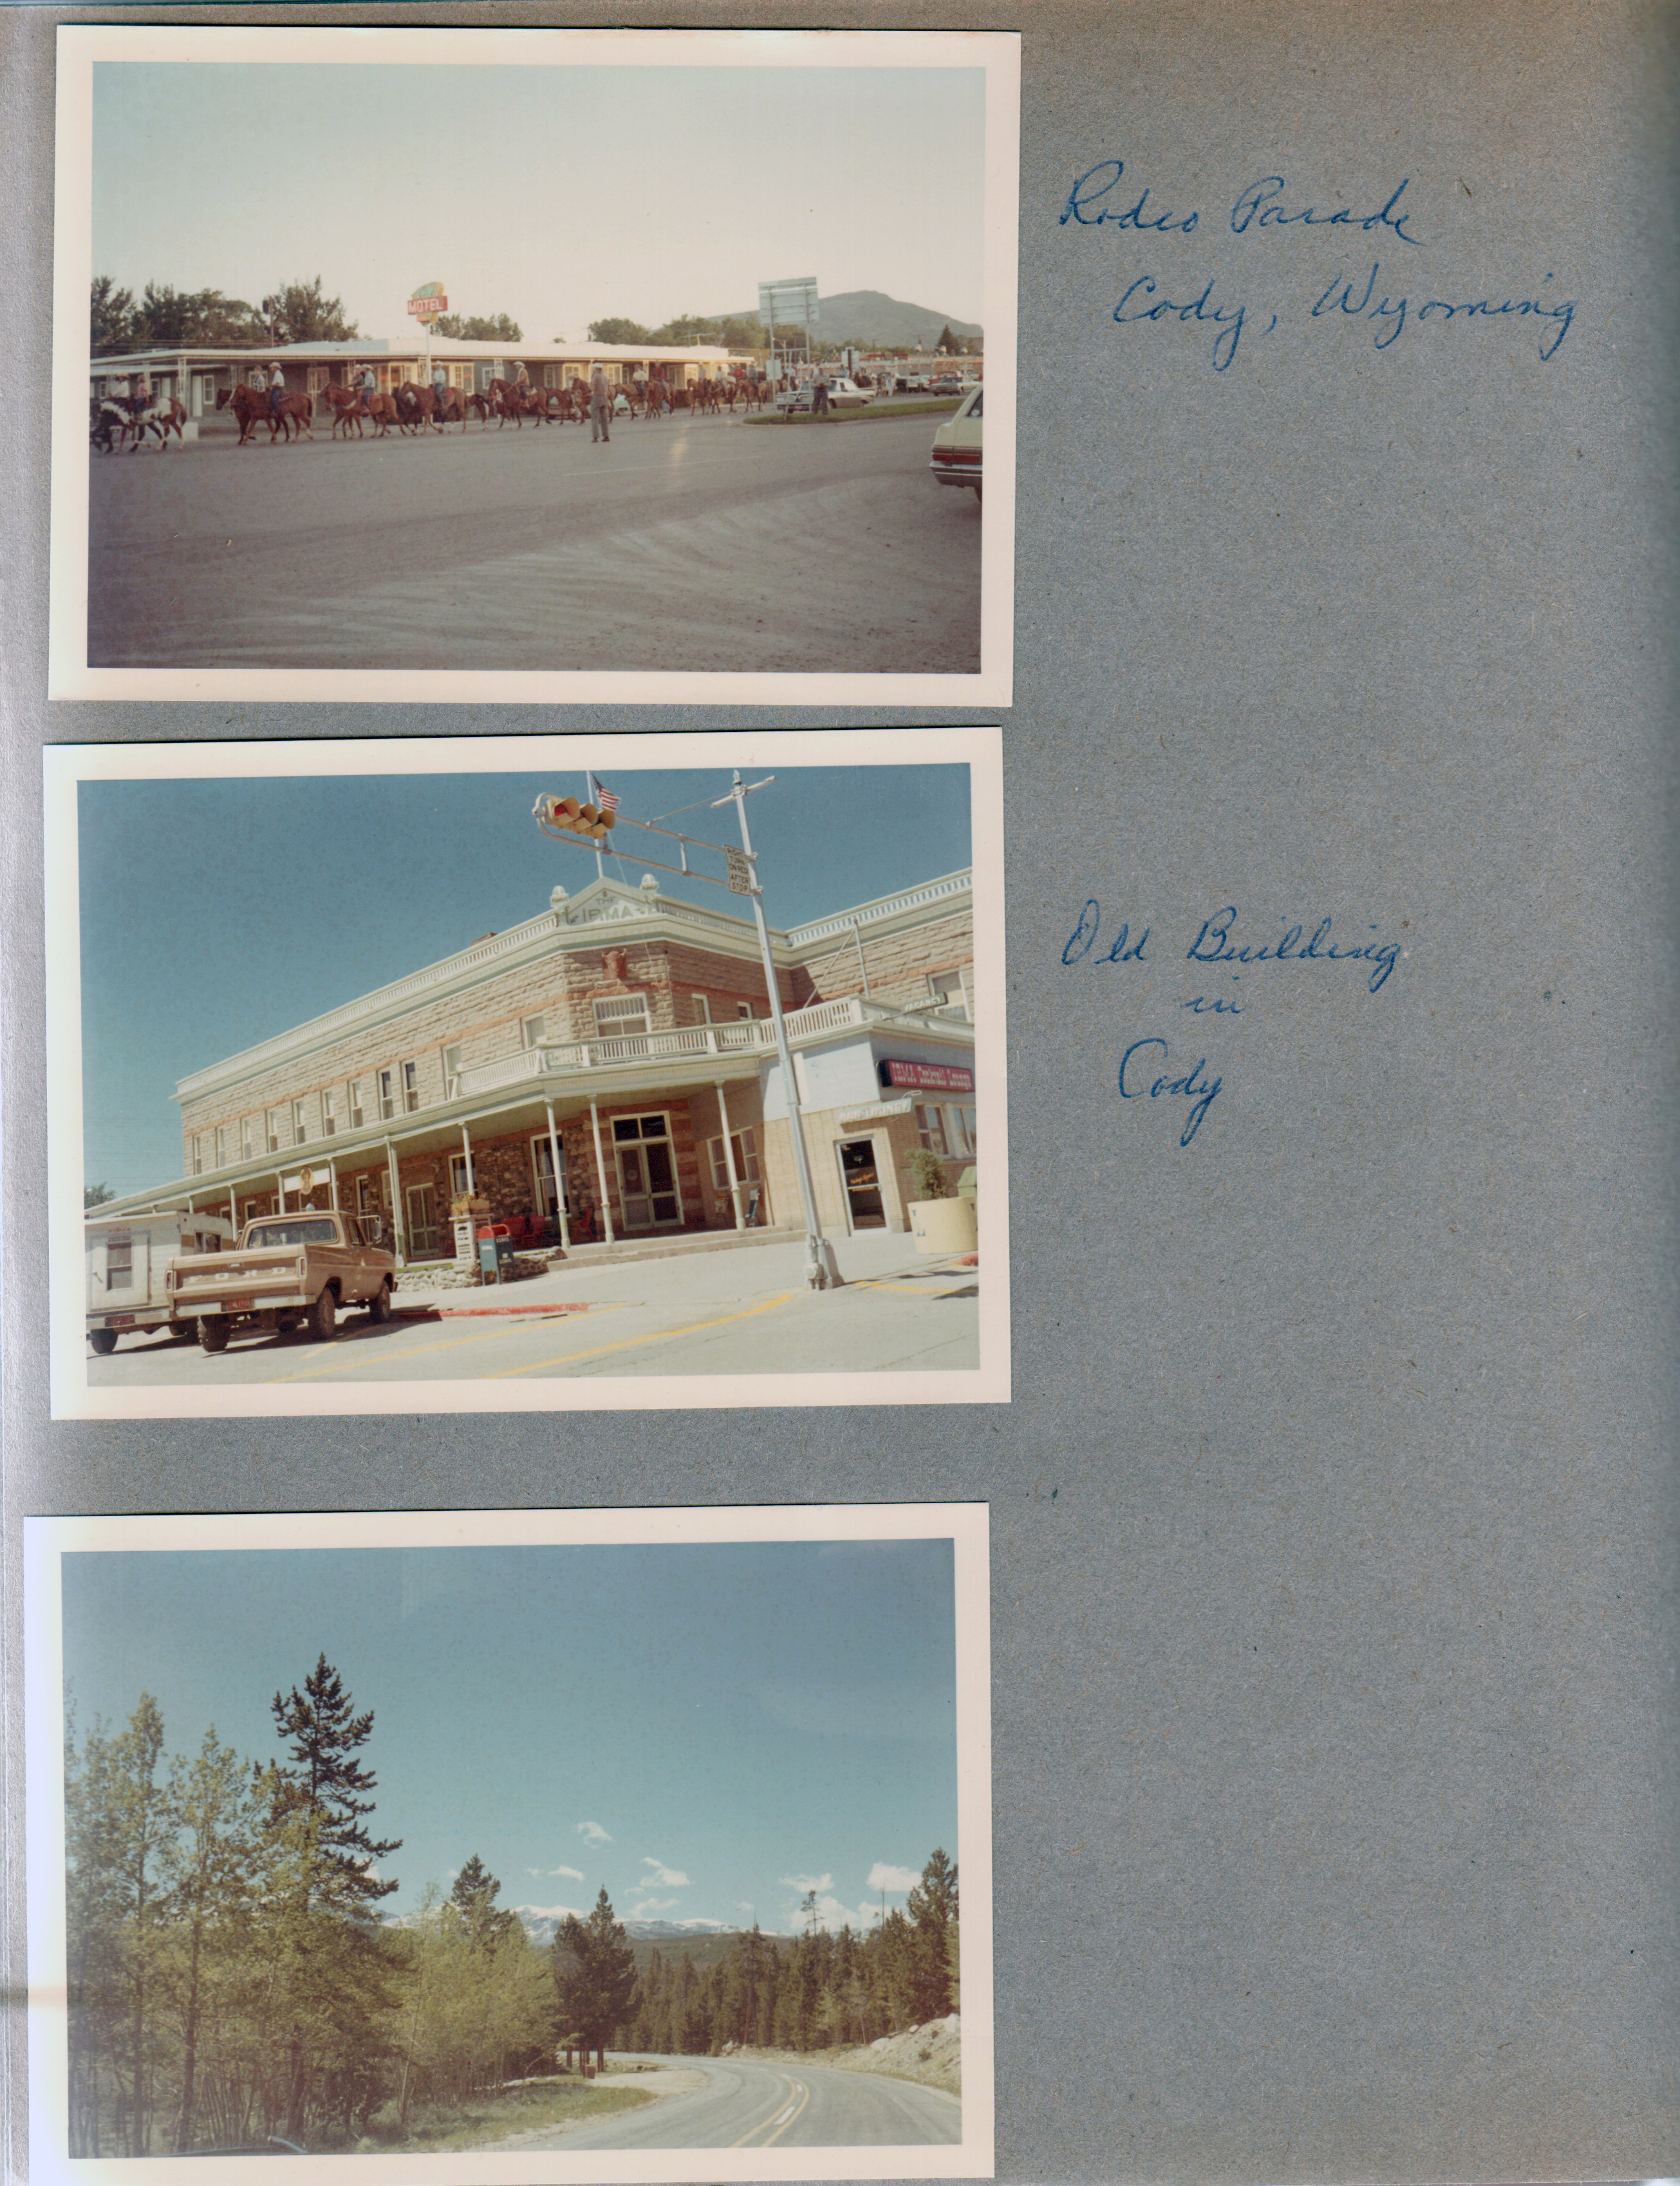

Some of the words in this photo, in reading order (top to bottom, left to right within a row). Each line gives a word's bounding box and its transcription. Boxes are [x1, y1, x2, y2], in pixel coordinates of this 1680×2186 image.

[1058, 160, 1199, 234] Rodeo
[1231, 176, 1421, 245] Parade
[408, 298, 443, 313] MOTEL
[1113, 276, 1277, 371] Cody,
[1311, 263, 1580, 362] Wyoming
[726, 847, 743, 857] RIGHT
[729, 855, 745, 866] TURN
[729, 863, 737, 871] ON
[737, 865, 748, 875] RED
[730, 873, 749, 884] AFTER
[732, 881, 748, 892] STOP
[595, 895, 617, 905] THE
[582, 905, 634, 923] IRMA
[1061, 898, 1151, 966] Old
[1186, 905, 1401, 994] Building
[1179, 975, 1242, 1015] in
[1117, 1037, 1223, 1148] Cody
[188, 1266, 287, 1284] FORD
